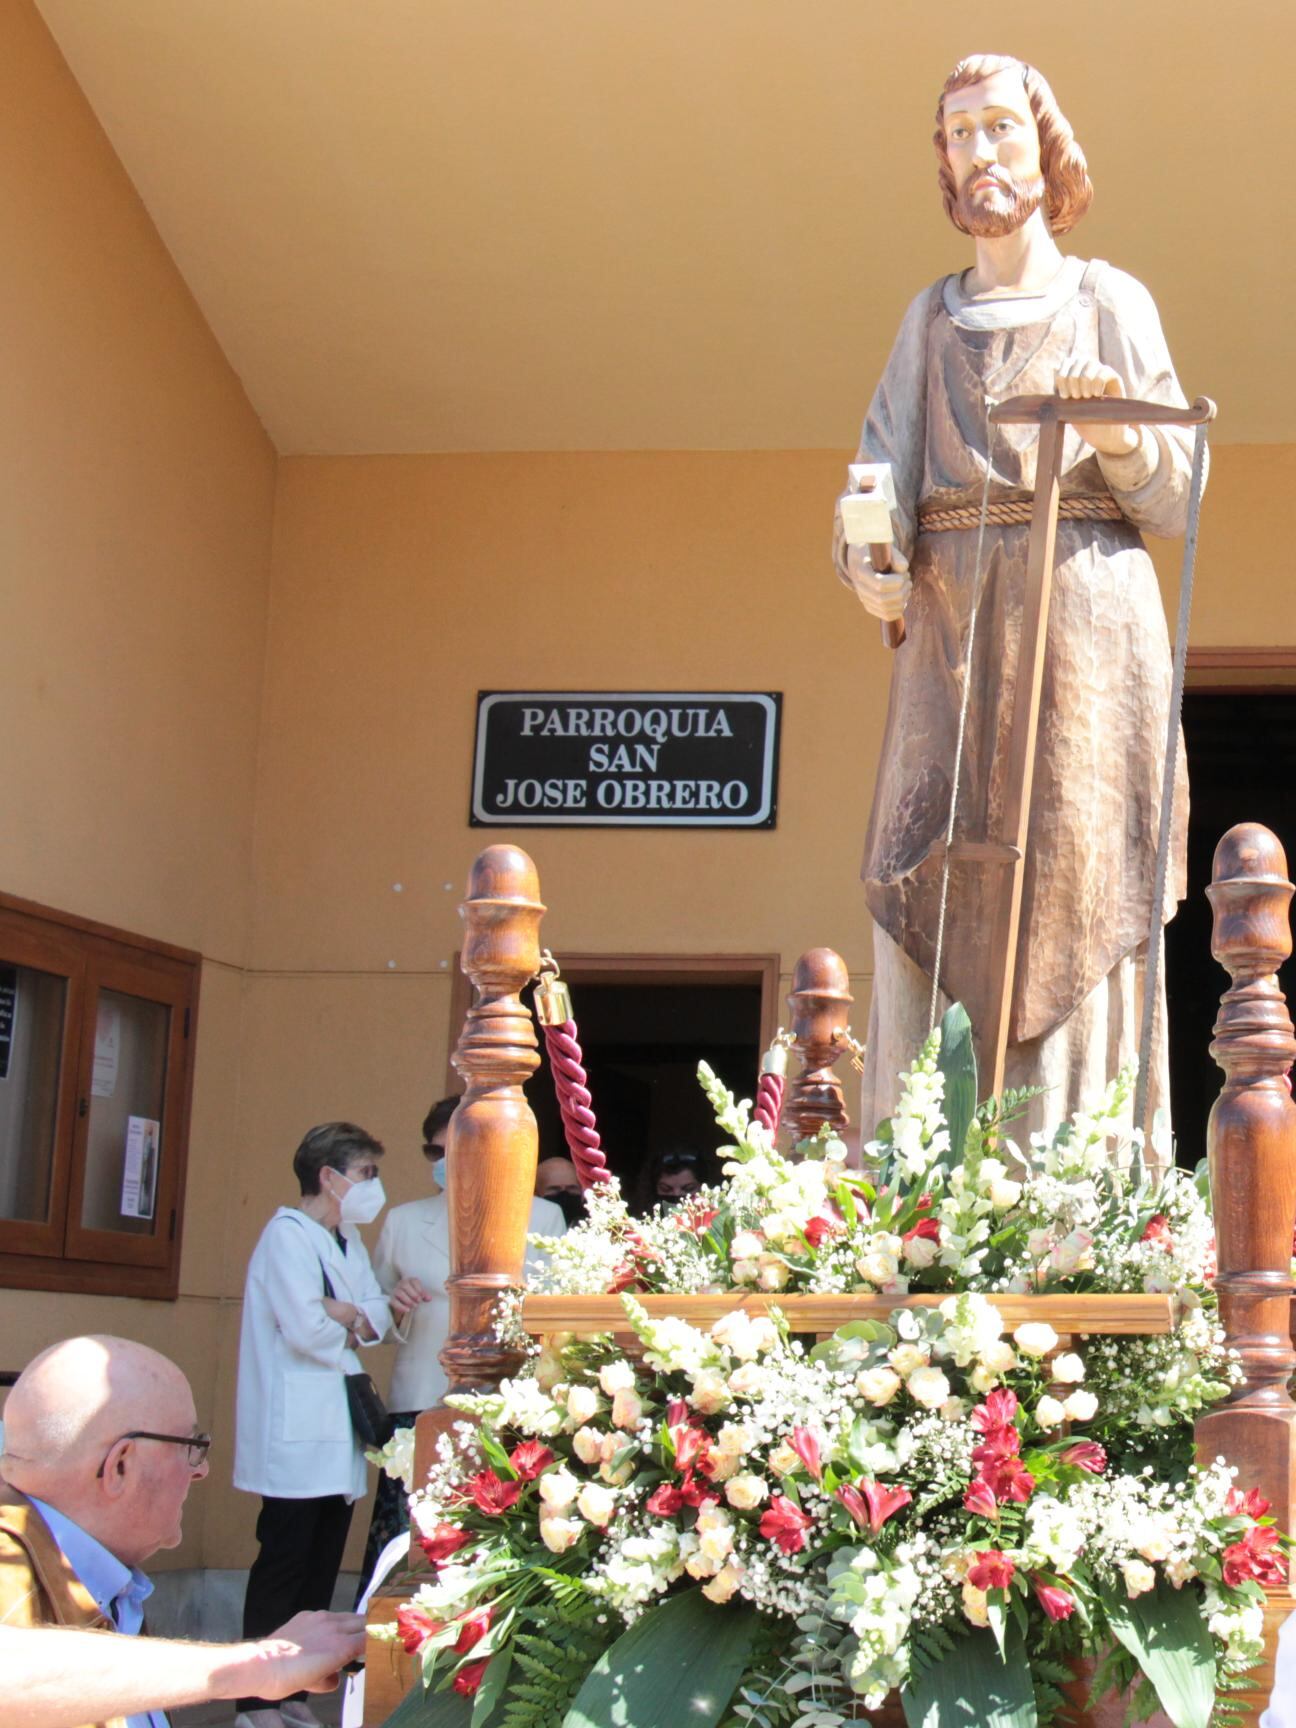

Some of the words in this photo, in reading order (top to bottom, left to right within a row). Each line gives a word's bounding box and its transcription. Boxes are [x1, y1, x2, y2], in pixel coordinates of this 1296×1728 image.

[519, 708, 733, 743] PARROQUIA
[588, 744, 661, 773] SAN
[495, 779, 588, 808] JOSE
[596, 779, 749, 810] OBRERO
